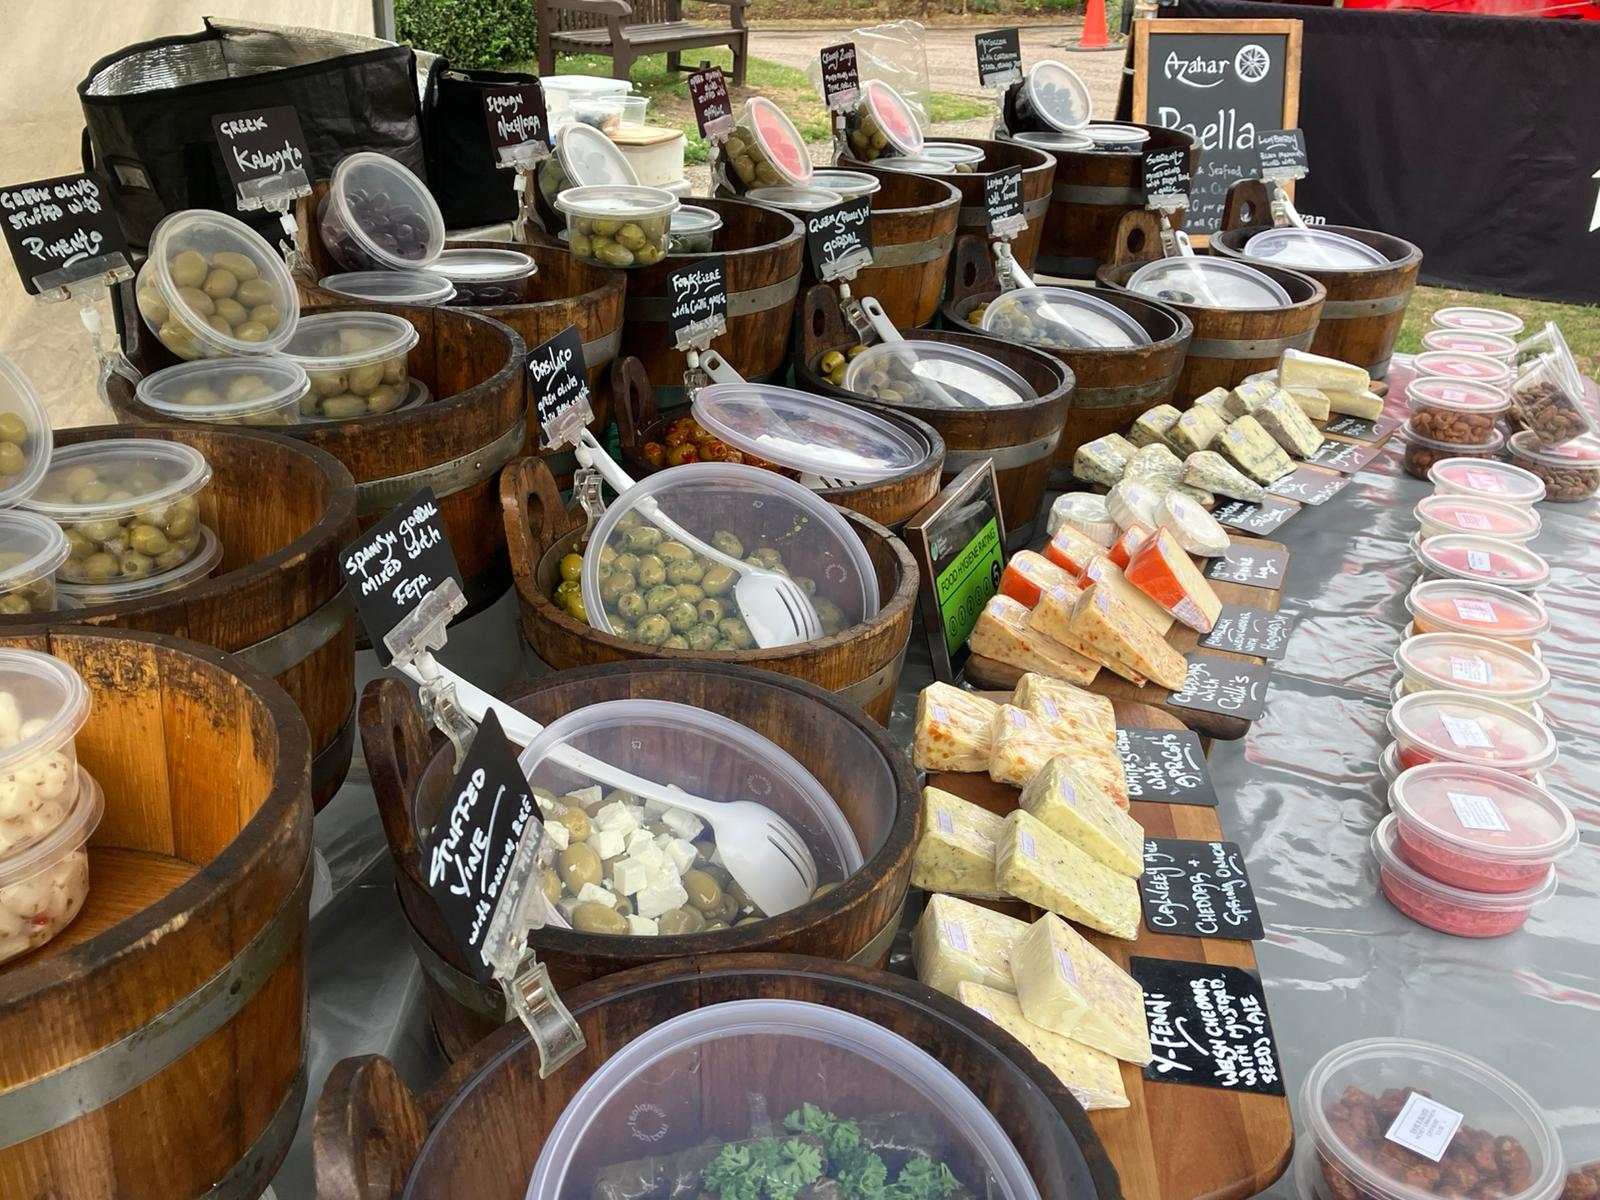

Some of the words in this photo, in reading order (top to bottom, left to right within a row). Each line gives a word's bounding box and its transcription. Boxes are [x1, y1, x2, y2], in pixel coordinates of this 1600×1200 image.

[1164, 51, 1230, 87] Azahar
[220, 116, 269, 140] GREEK
[346, 531, 398, 578] SPANISH
[361, 559, 402, 596] MIXED
[941, 567, 957, 593] FOOD
[957, 545, 978, 578] HYGIENE
[977, 527, 996, 556] RATING
[429, 768, 485, 888] STUFFED
[450, 827, 488, 897] VINE
[1189, 872, 1221, 934] CHEDDAR
[1221, 880, 1252, 925] SPRING
[1190, 978, 1224, 1037] CHEDDAR
[1210, 978, 1252, 1039] MUSTARD
[1240, 994, 1266, 1025] ALE
[1234, 1045, 1257, 1086] WITH
[1253, 1037, 1278, 1084] SEEDS
